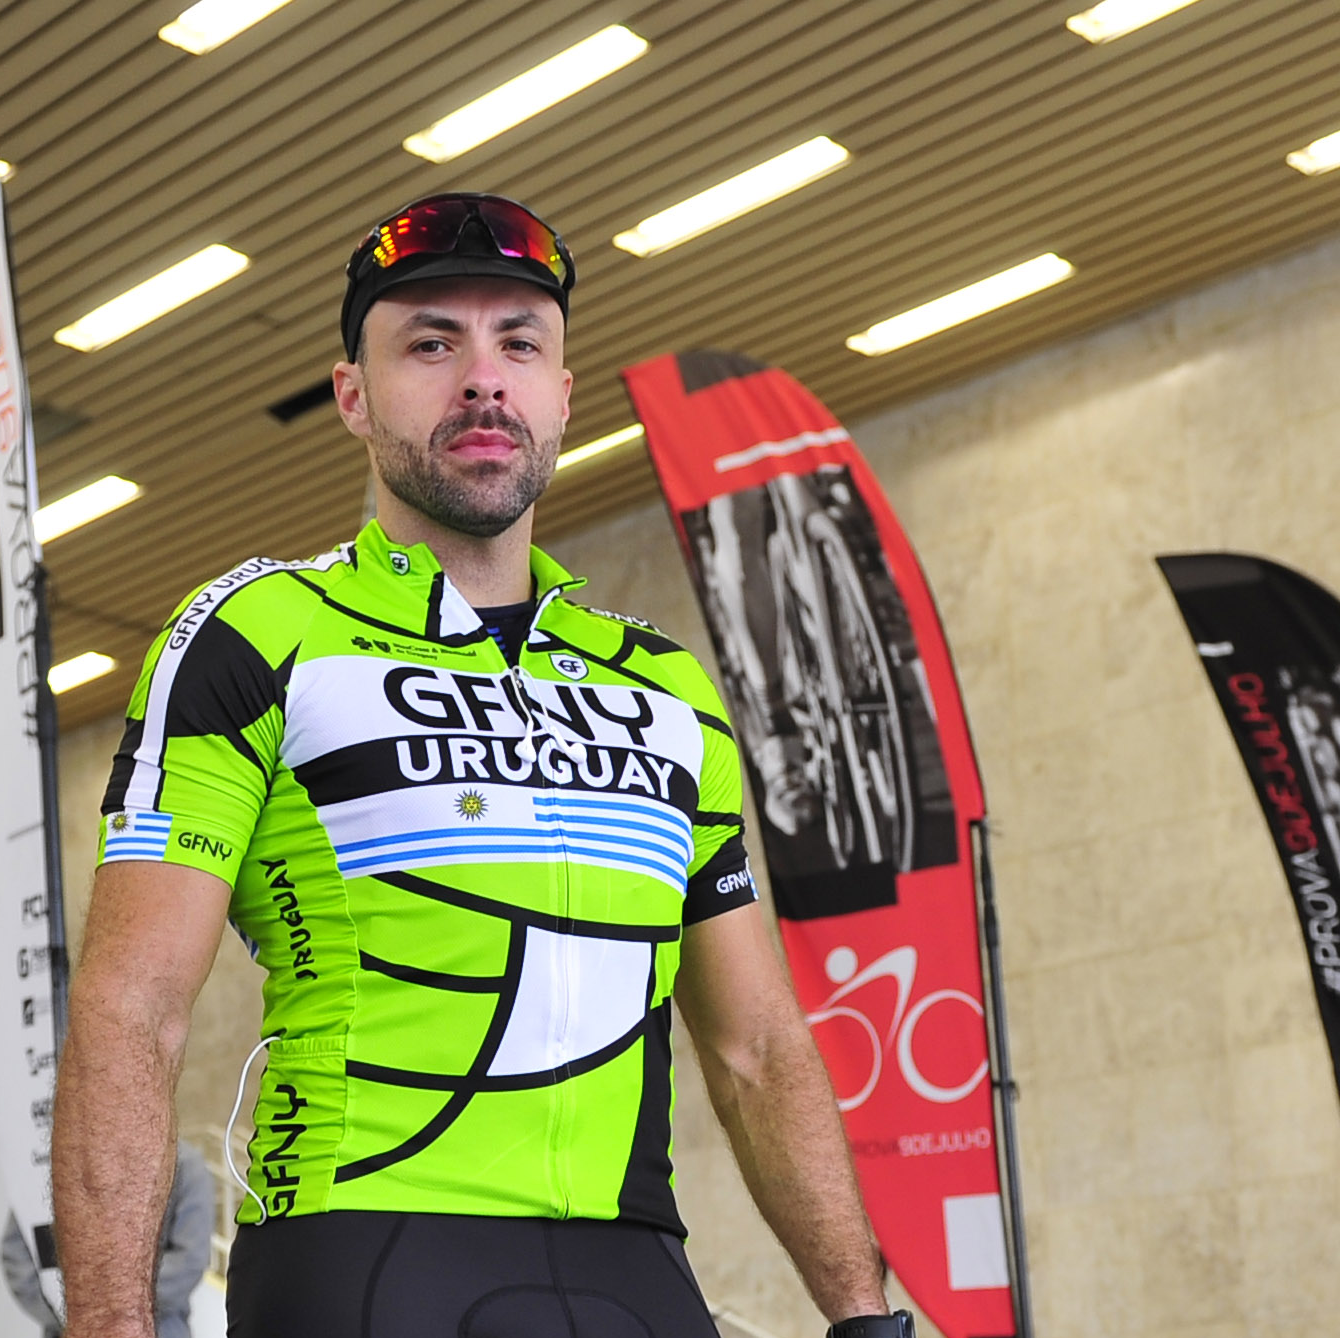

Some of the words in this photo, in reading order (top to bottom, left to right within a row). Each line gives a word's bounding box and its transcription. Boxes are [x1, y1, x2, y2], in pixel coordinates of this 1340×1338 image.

[169, 592, 214, 650] GFNY
[213, 556, 297, 589] URUG
[383, 666, 654, 748] GFNY
[396, 737, 673, 800] URUGUAY
[178, 832, 232, 861] GFNY
[262, 1084, 309, 1219] GFNY
